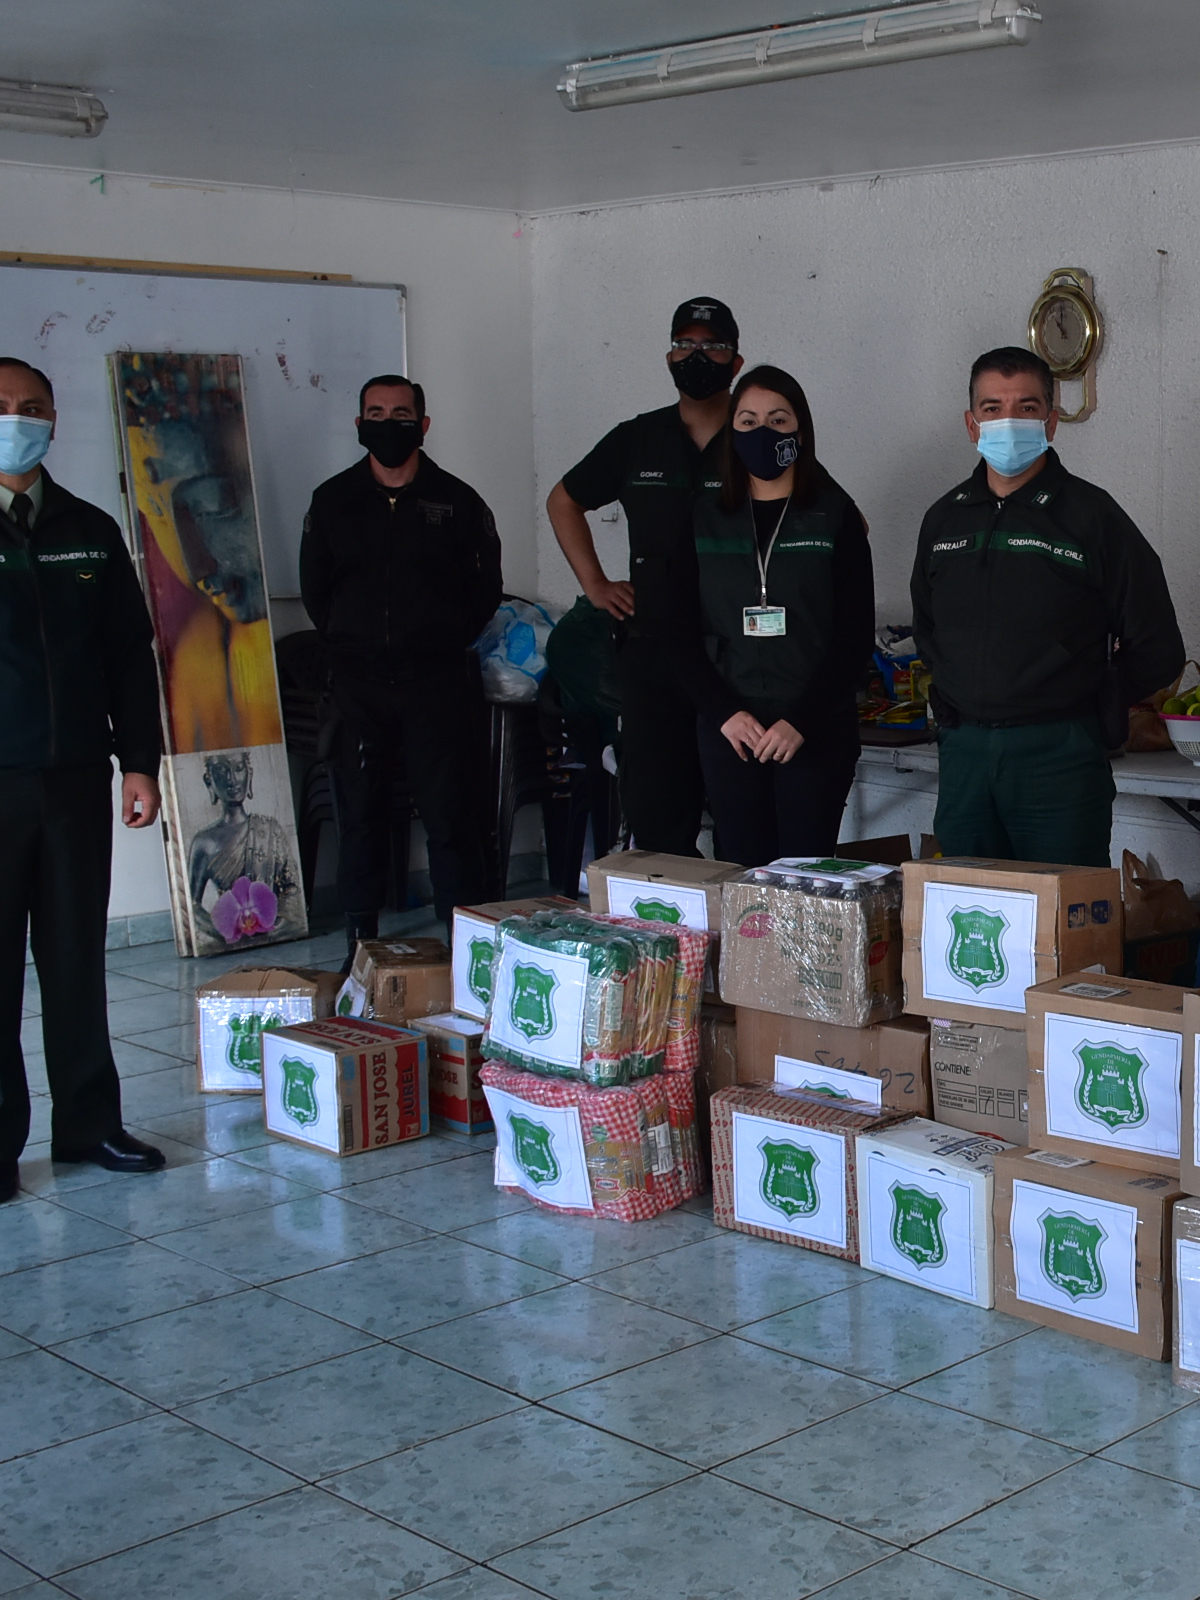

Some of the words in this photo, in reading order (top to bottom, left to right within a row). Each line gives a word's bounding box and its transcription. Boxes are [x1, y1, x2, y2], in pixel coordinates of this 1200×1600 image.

[933, 540, 967, 552] GONZALEZ
[1008, 538, 1052, 551] GENDARMERIA
[1053, 547, 1063, 556] DE
[1065, 550, 1084, 562] CHILE
[38, 551, 88, 562] GENDARMERIA
[89, 551, 99, 559] DE
[961, 916, 994, 927] GENDARMERIA
[1091, 1053, 1131, 1066] GENDARMERIA
[372, 1049, 390, 1100] JOSE
[402, 1063, 416, 1117] JUREL
[374, 1104, 389, 1144] SAN
[1054, 1222, 1090, 1237] GENDARMERIA
